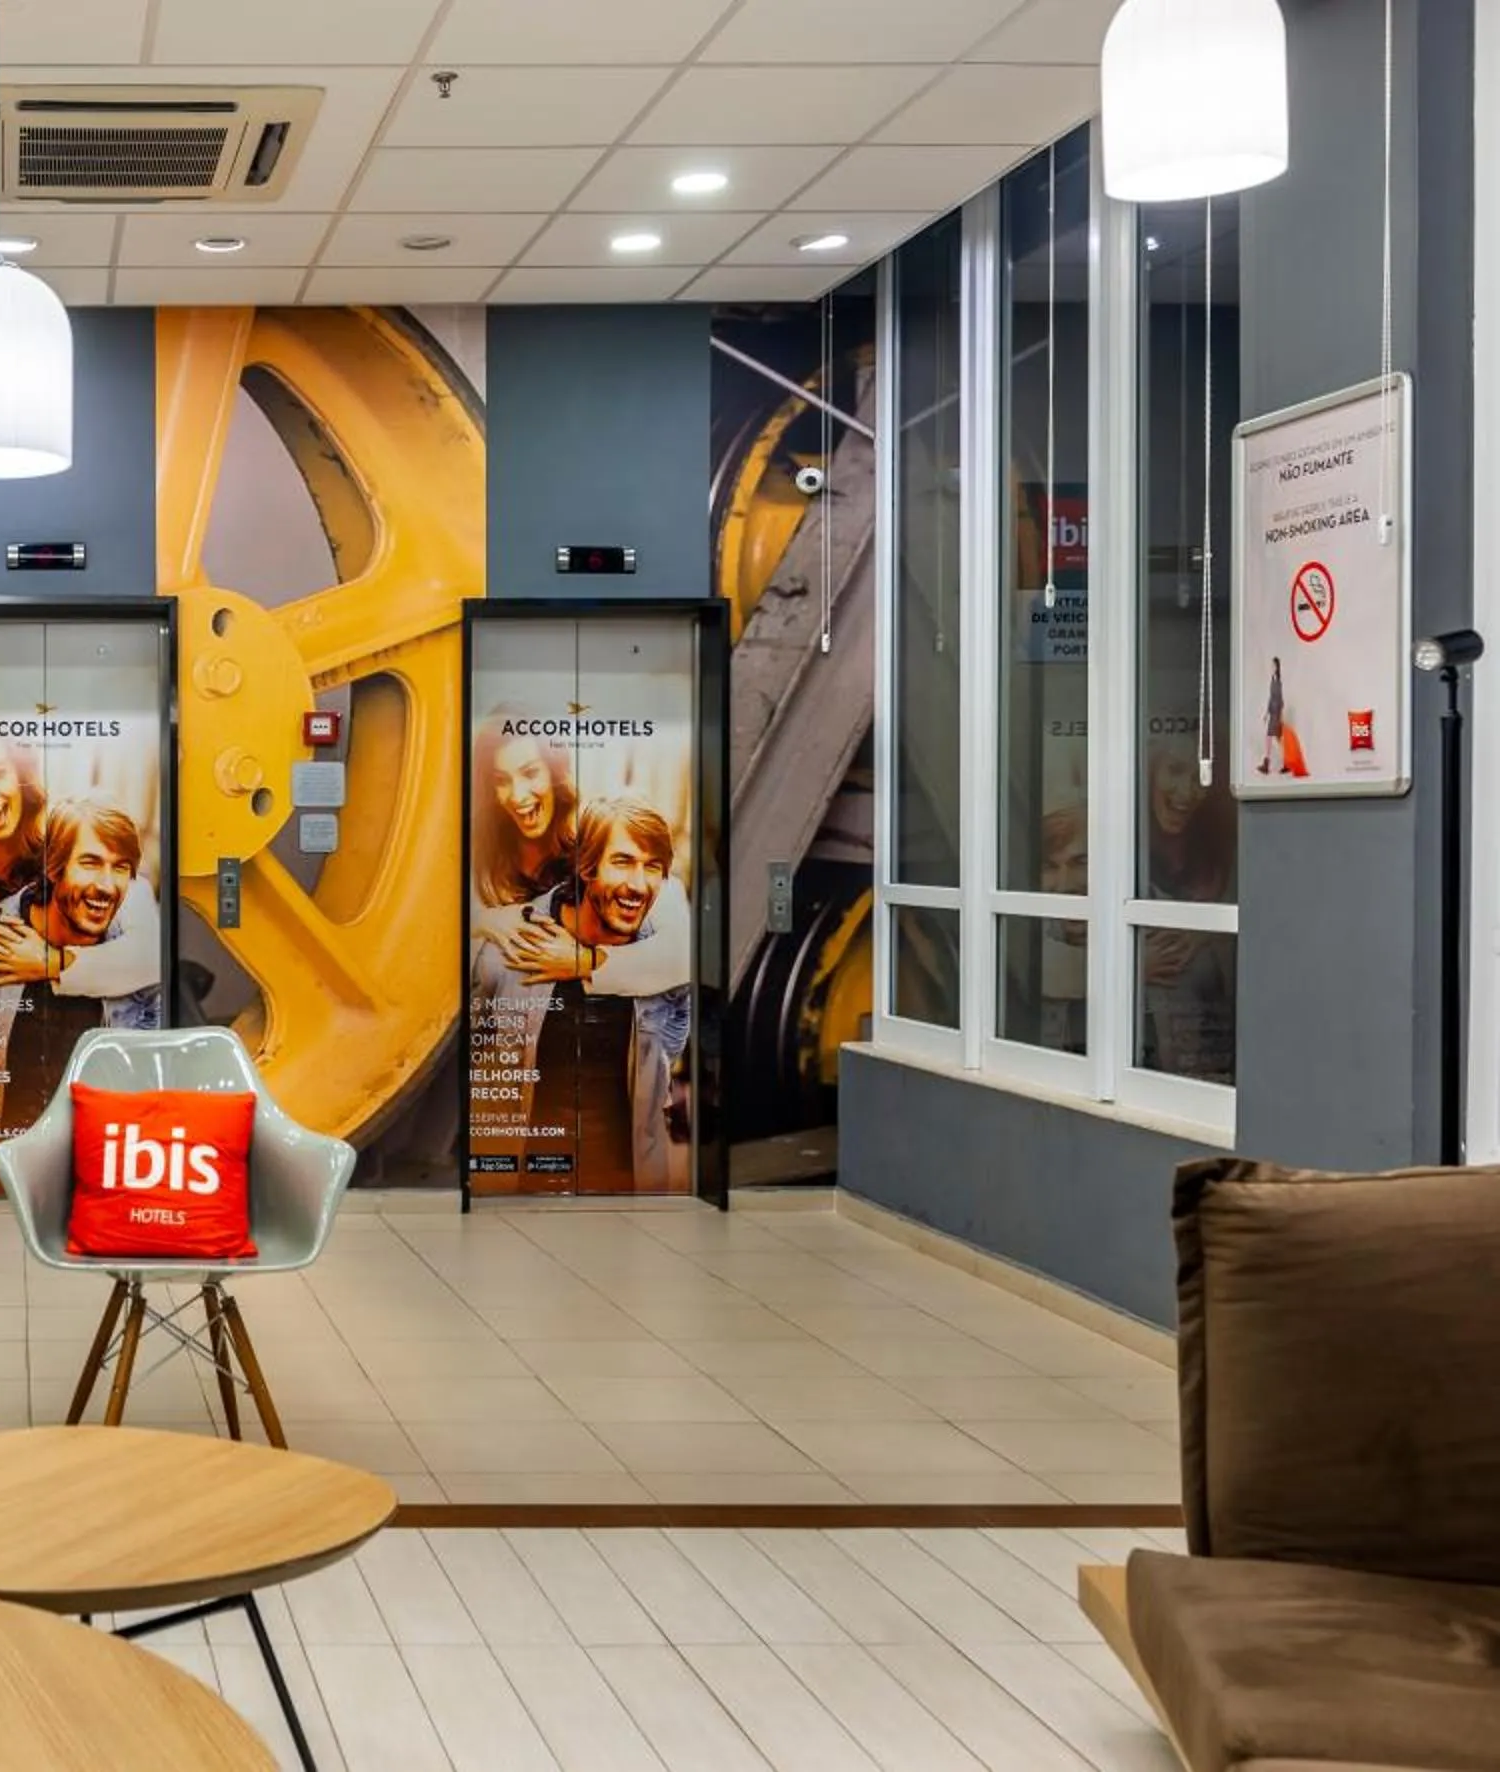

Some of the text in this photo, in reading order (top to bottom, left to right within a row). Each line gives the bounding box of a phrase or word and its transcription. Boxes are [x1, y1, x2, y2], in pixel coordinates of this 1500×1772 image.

[1279, 464, 1301, 483] NÃO
[1302, 449, 1355, 477] FUMANTE
[1051, 516, 1088, 547] ibi
[1265, 514, 1337, 544] NON-SMOKING
[1338, 507, 1370, 526] AREA
[1031, 612, 1088, 624] DE VEIC
[485, 997, 565, 1011] MELHORES
[471, 1033, 537, 1048] OMEÇAM
[471, 1051, 520, 1065] OM OS
[469, 1069, 541, 1083] ELHORES
[471, 1087, 524, 1102] REÇOS.
[469, 1126, 565, 1137] CCORHOTELS.COM
[102, 1122, 221, 1195] ibis
[129, 1207, 188, 1226] HOTELS
